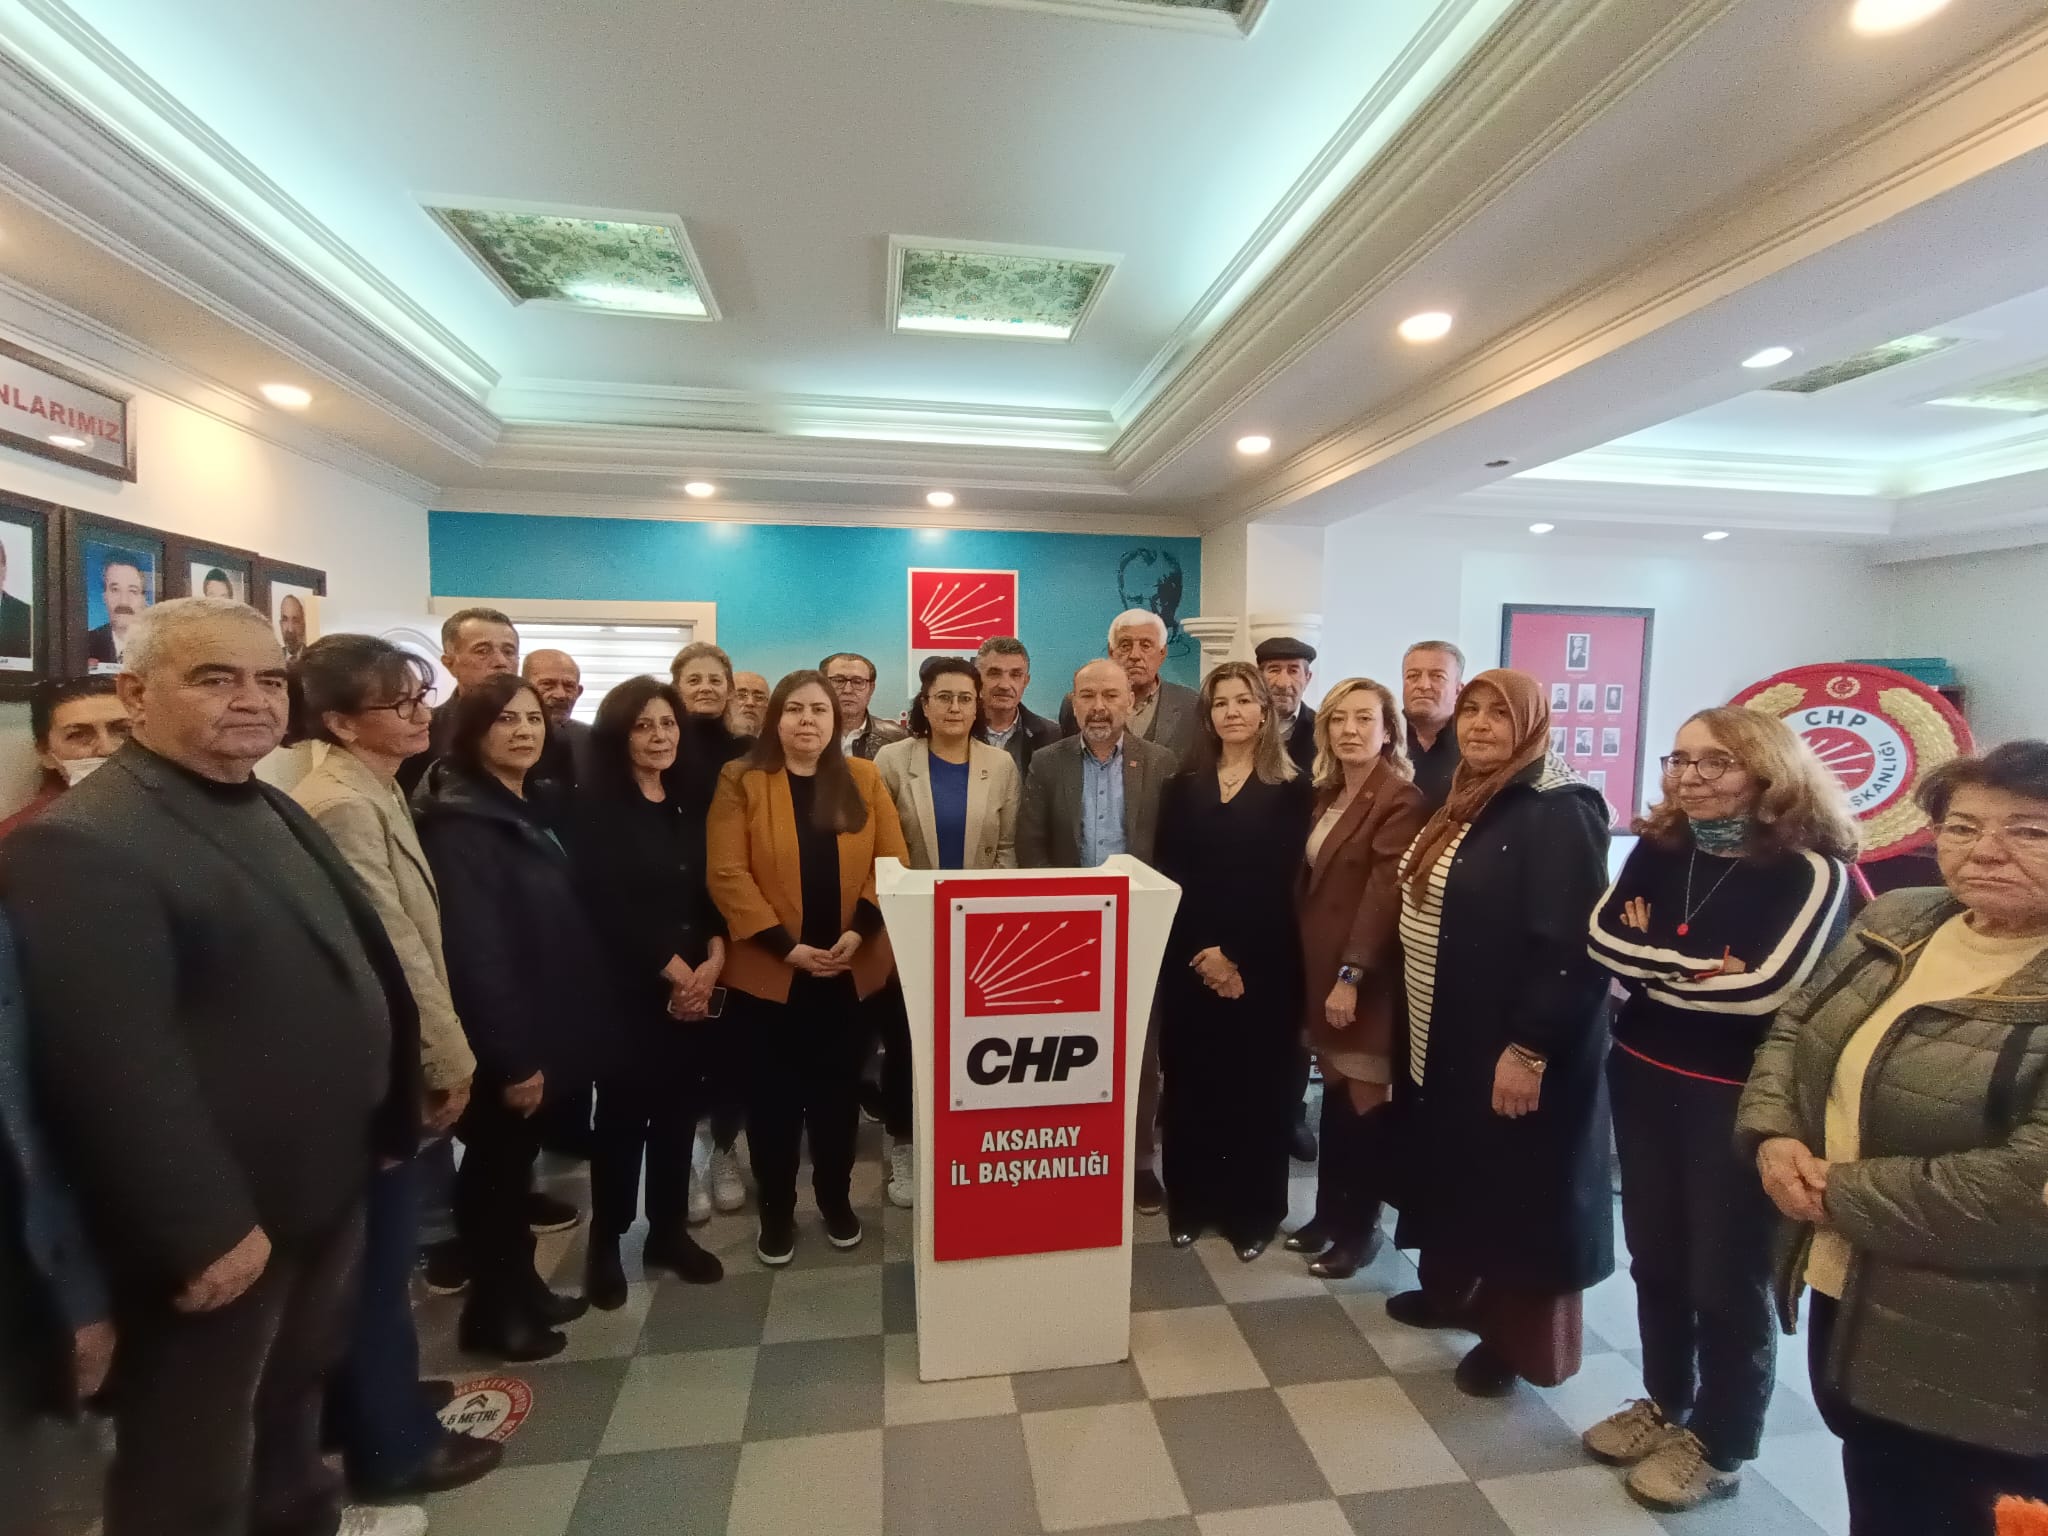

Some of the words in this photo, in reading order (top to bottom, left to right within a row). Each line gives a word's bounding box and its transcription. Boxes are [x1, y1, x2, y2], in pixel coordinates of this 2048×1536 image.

[1804, 709, 1867, 727] CHP
[1849, 740, 1897, 807] ŞKANLIĞI
[966, 1035, 1099, 1086] CHP
[981, 1126, 1081, 1153] AKSARAY
[951, 1160, 971, 1186] İL
[979, 1151, 1109, 1187] BAŞKANLIĞI
[458, 1409, 501, 1425] METRE
